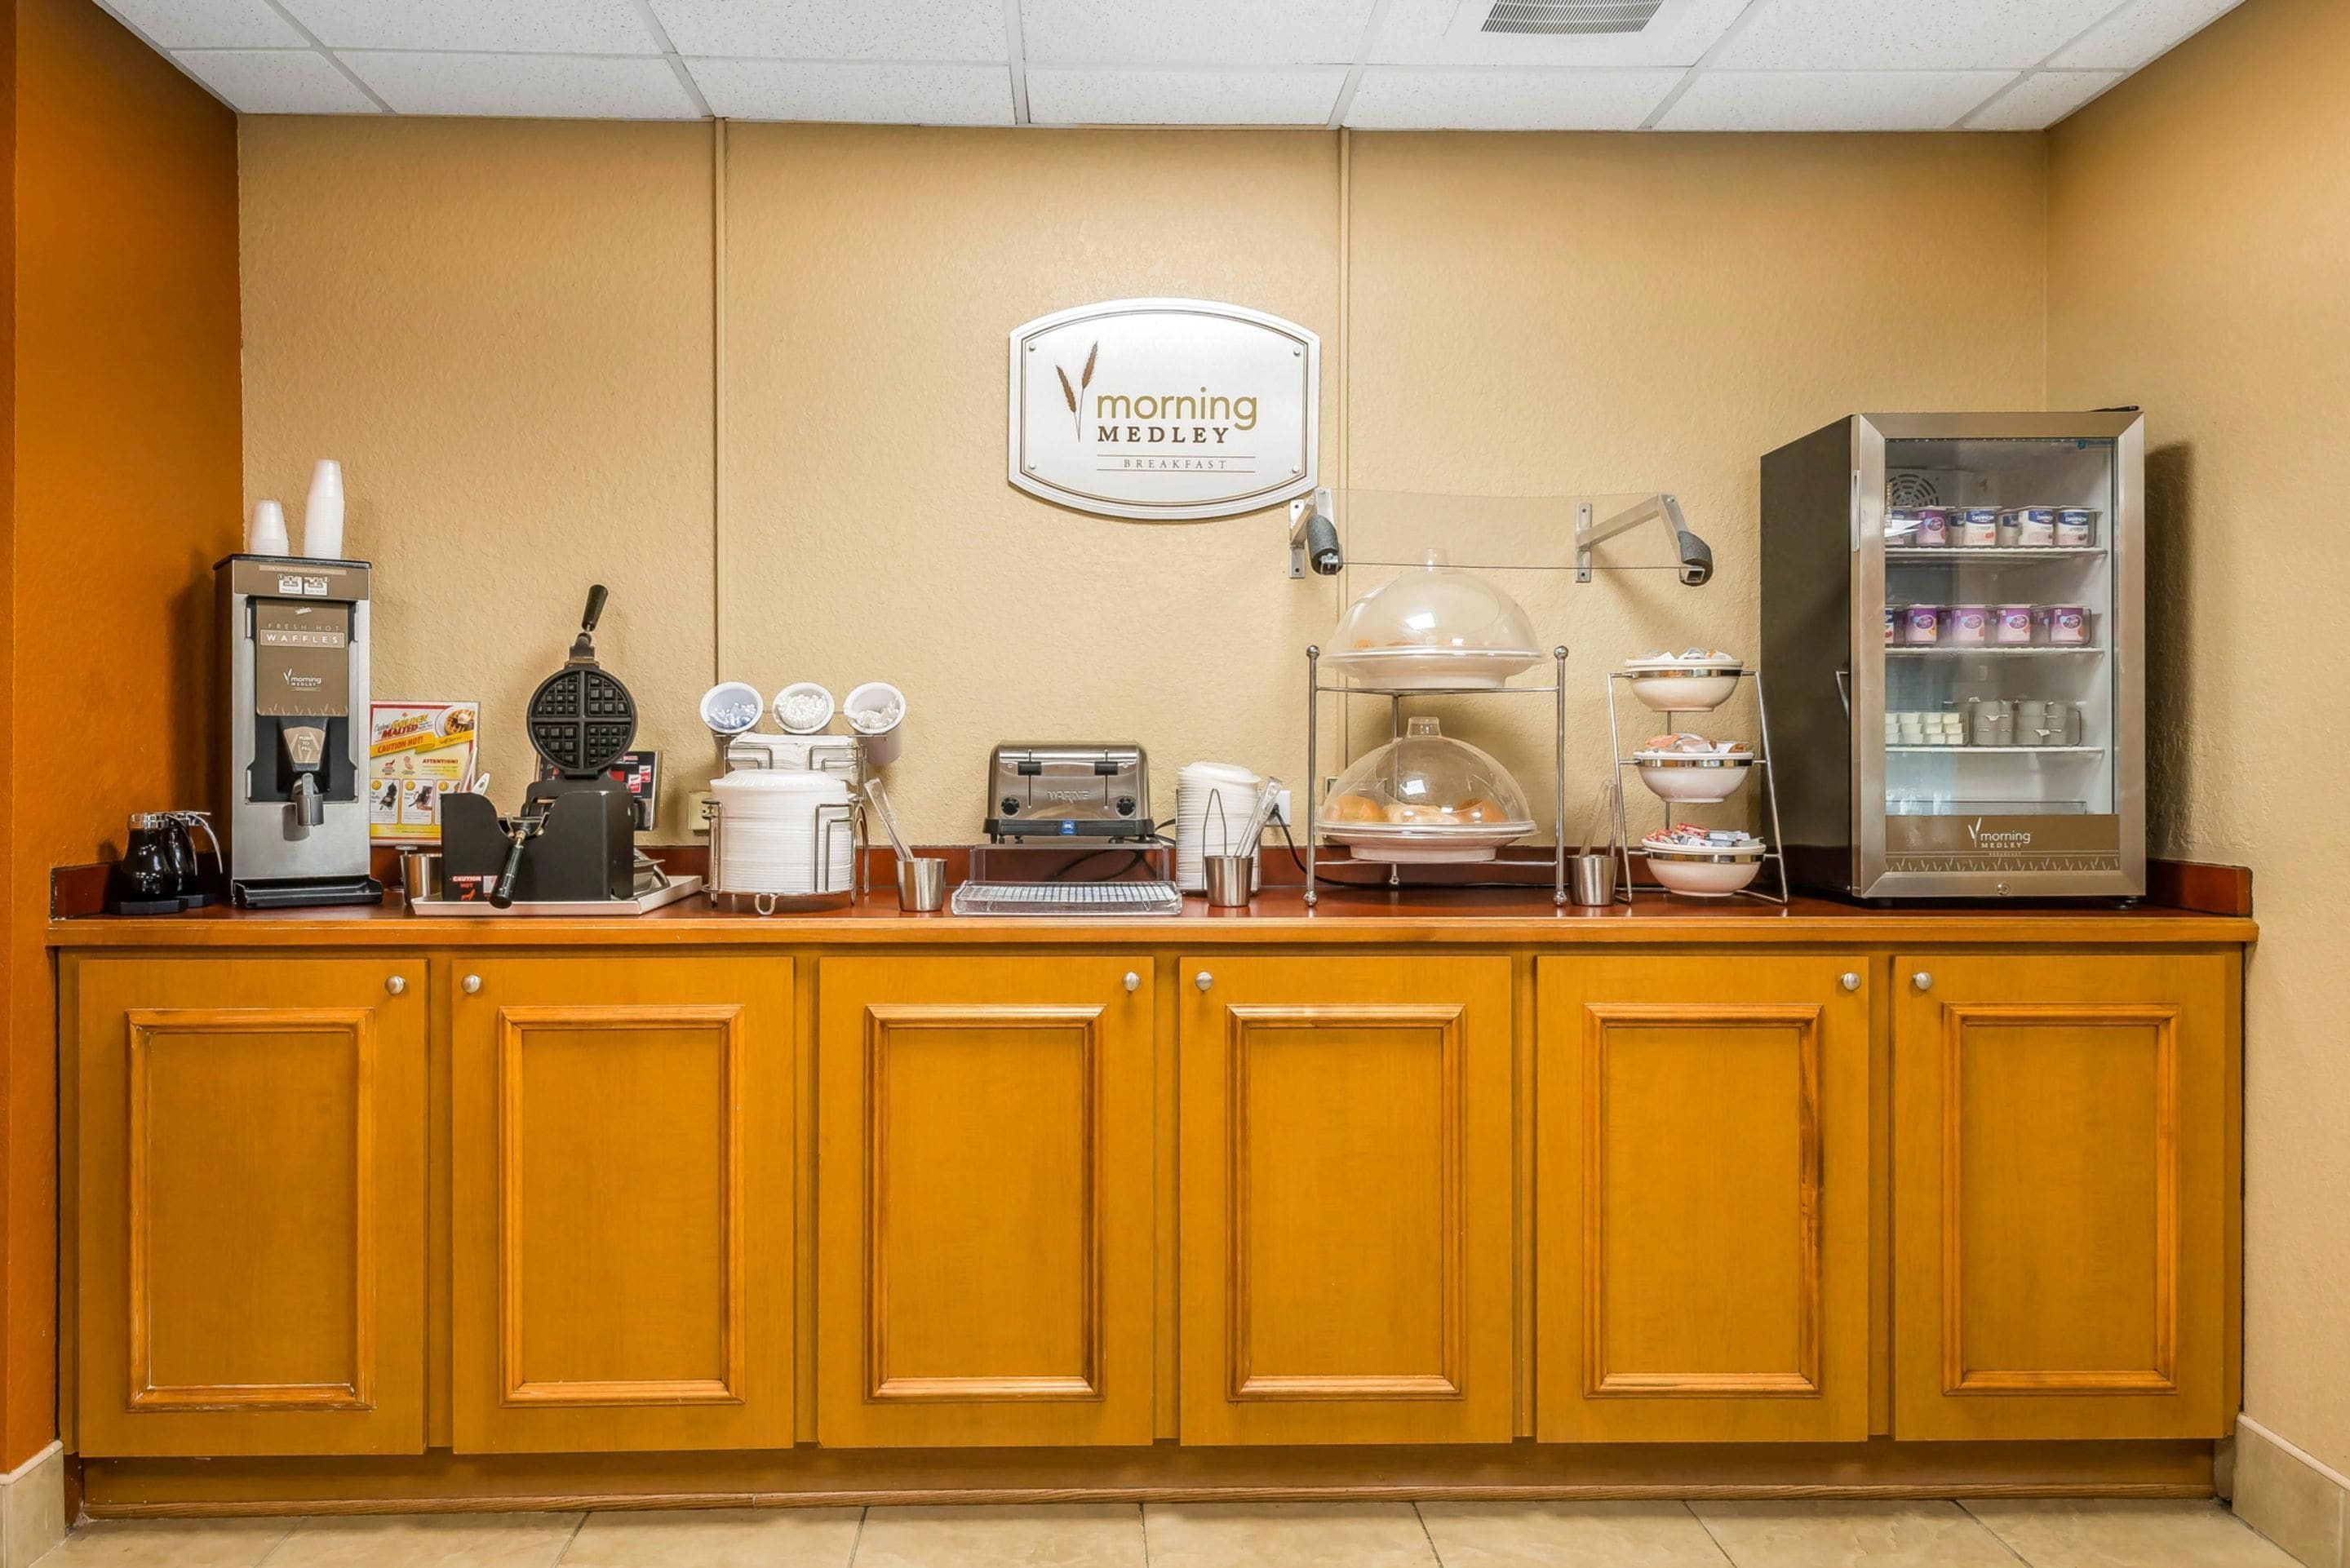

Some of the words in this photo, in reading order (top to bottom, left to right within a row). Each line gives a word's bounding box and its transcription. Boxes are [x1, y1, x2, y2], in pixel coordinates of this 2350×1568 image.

[1097, 386, 1257, 432] morning
[1097, 426, 1230, 444] MEDLEY
[1123, 458, 1228, 470] BREAKFAST
[268, 622, 308, 631] FRESH
[266, 634, 339, 644] WAFFLES
[290, 675, 322, 684] morning
[381, 724, 419, 738] MALTED
[378, 739, 406, 754] CAUTION
[1980, 830, 2031, 844] morning
